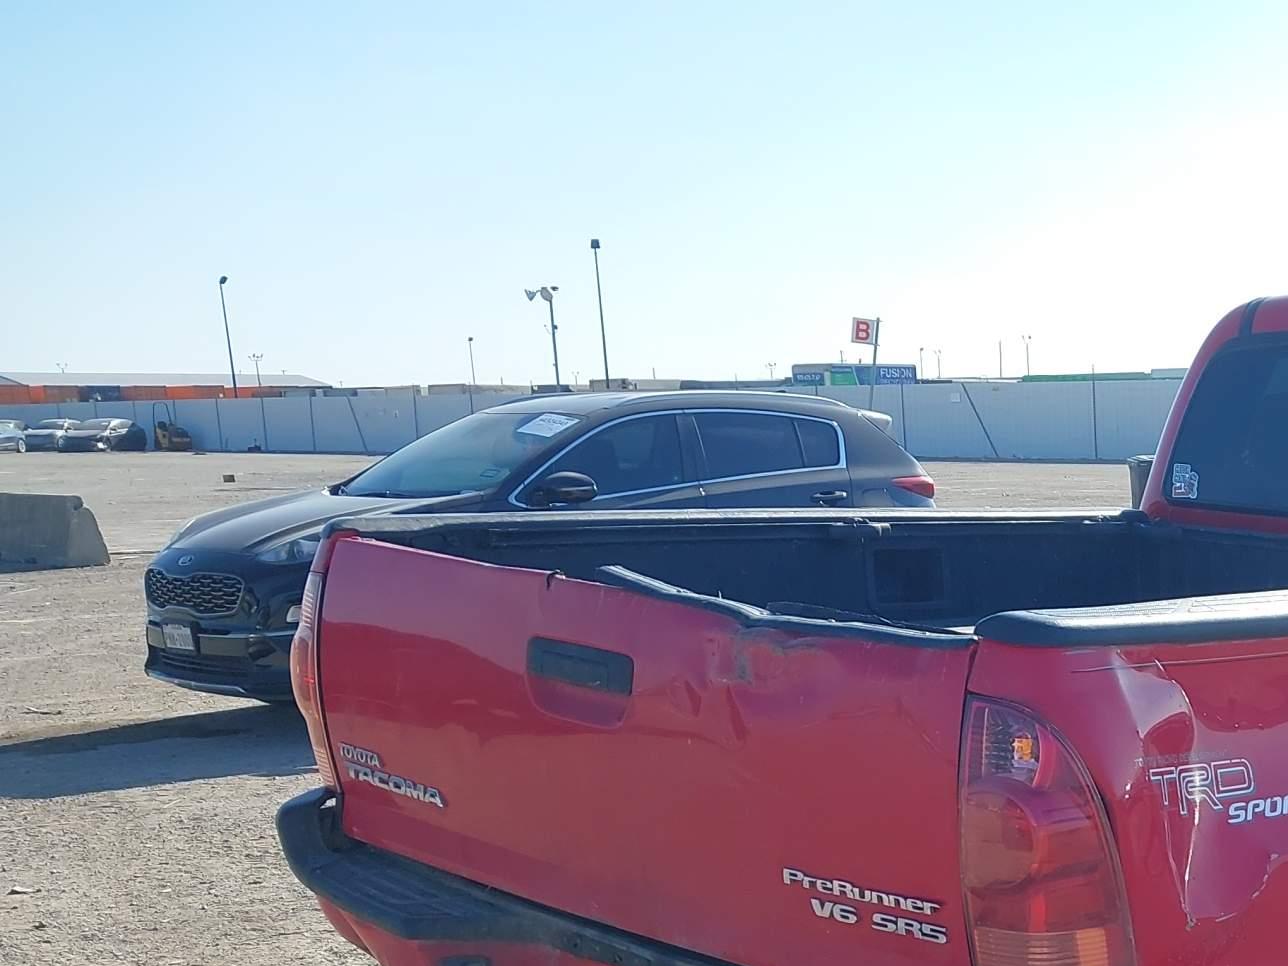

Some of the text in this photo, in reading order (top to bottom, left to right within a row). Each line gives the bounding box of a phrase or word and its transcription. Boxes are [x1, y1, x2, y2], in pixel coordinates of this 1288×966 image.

[855, 320, 871, 341] B
[339, 743, 381, 769] TOYOTA
[345, 761, 444, 808] TACOMA
[1150, 758, 1255, 816] TRD
[782, 867, 942, 916] PreRunner
[810, 898, 948, 945] V6 SR5
